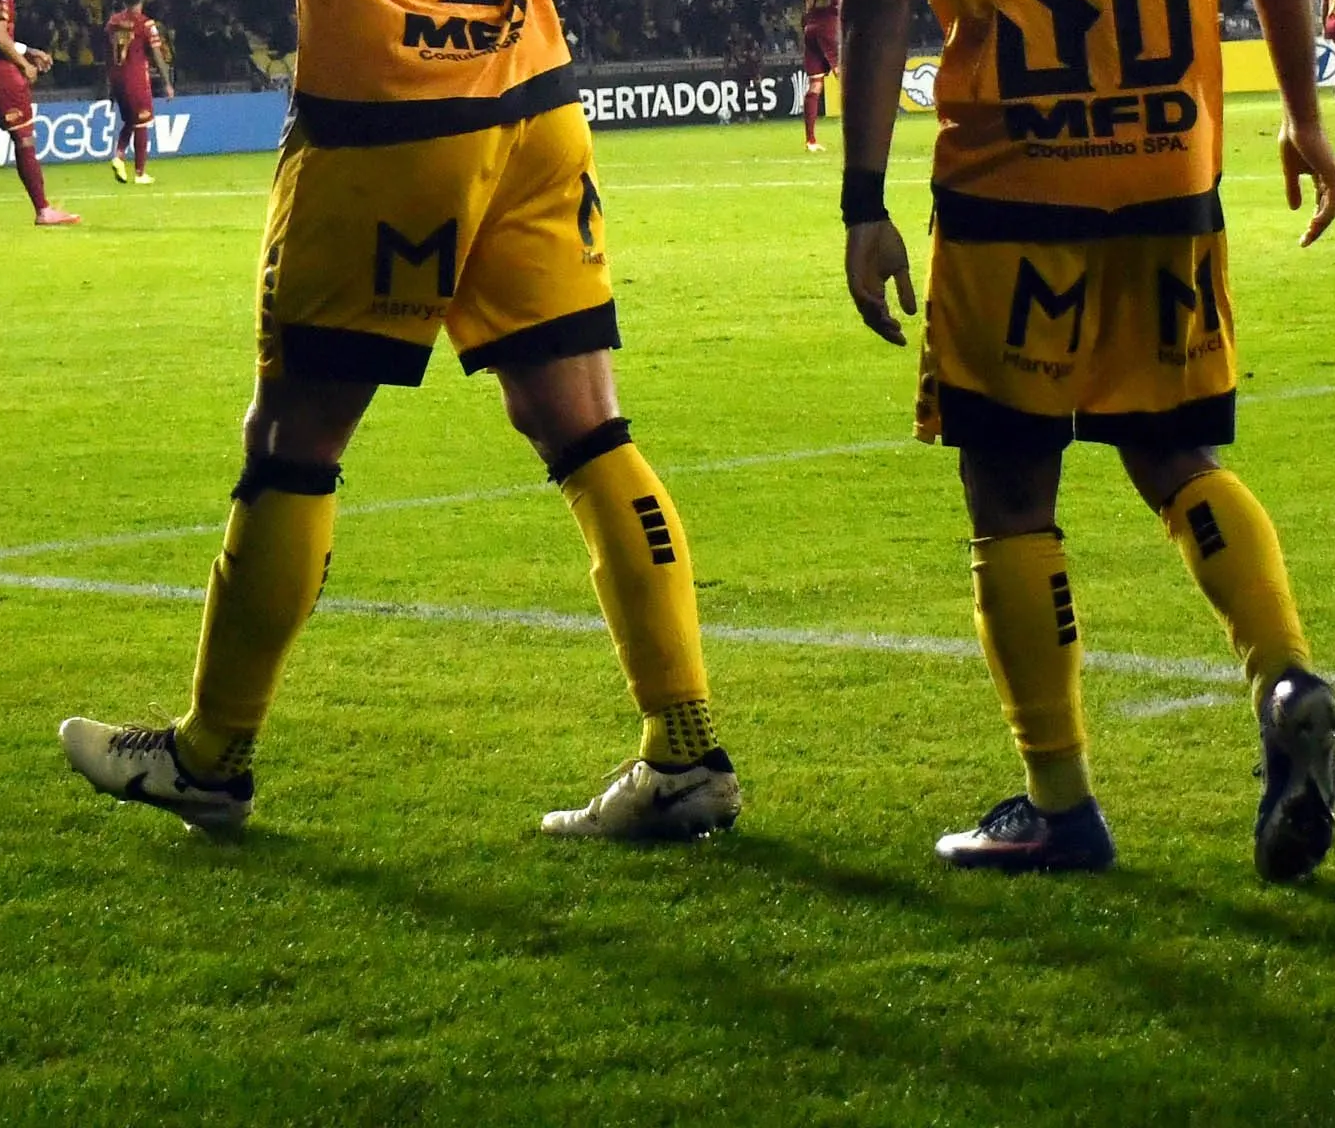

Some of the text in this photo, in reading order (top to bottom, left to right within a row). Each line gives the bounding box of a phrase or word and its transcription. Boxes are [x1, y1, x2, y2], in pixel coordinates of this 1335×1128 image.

[1004, 90, 1198, 142] MFD
[1029, 142, 1137, 162] Coquimbo
[374, 218, 457, 297] M
[1007, 250, 1219, 353] M M
